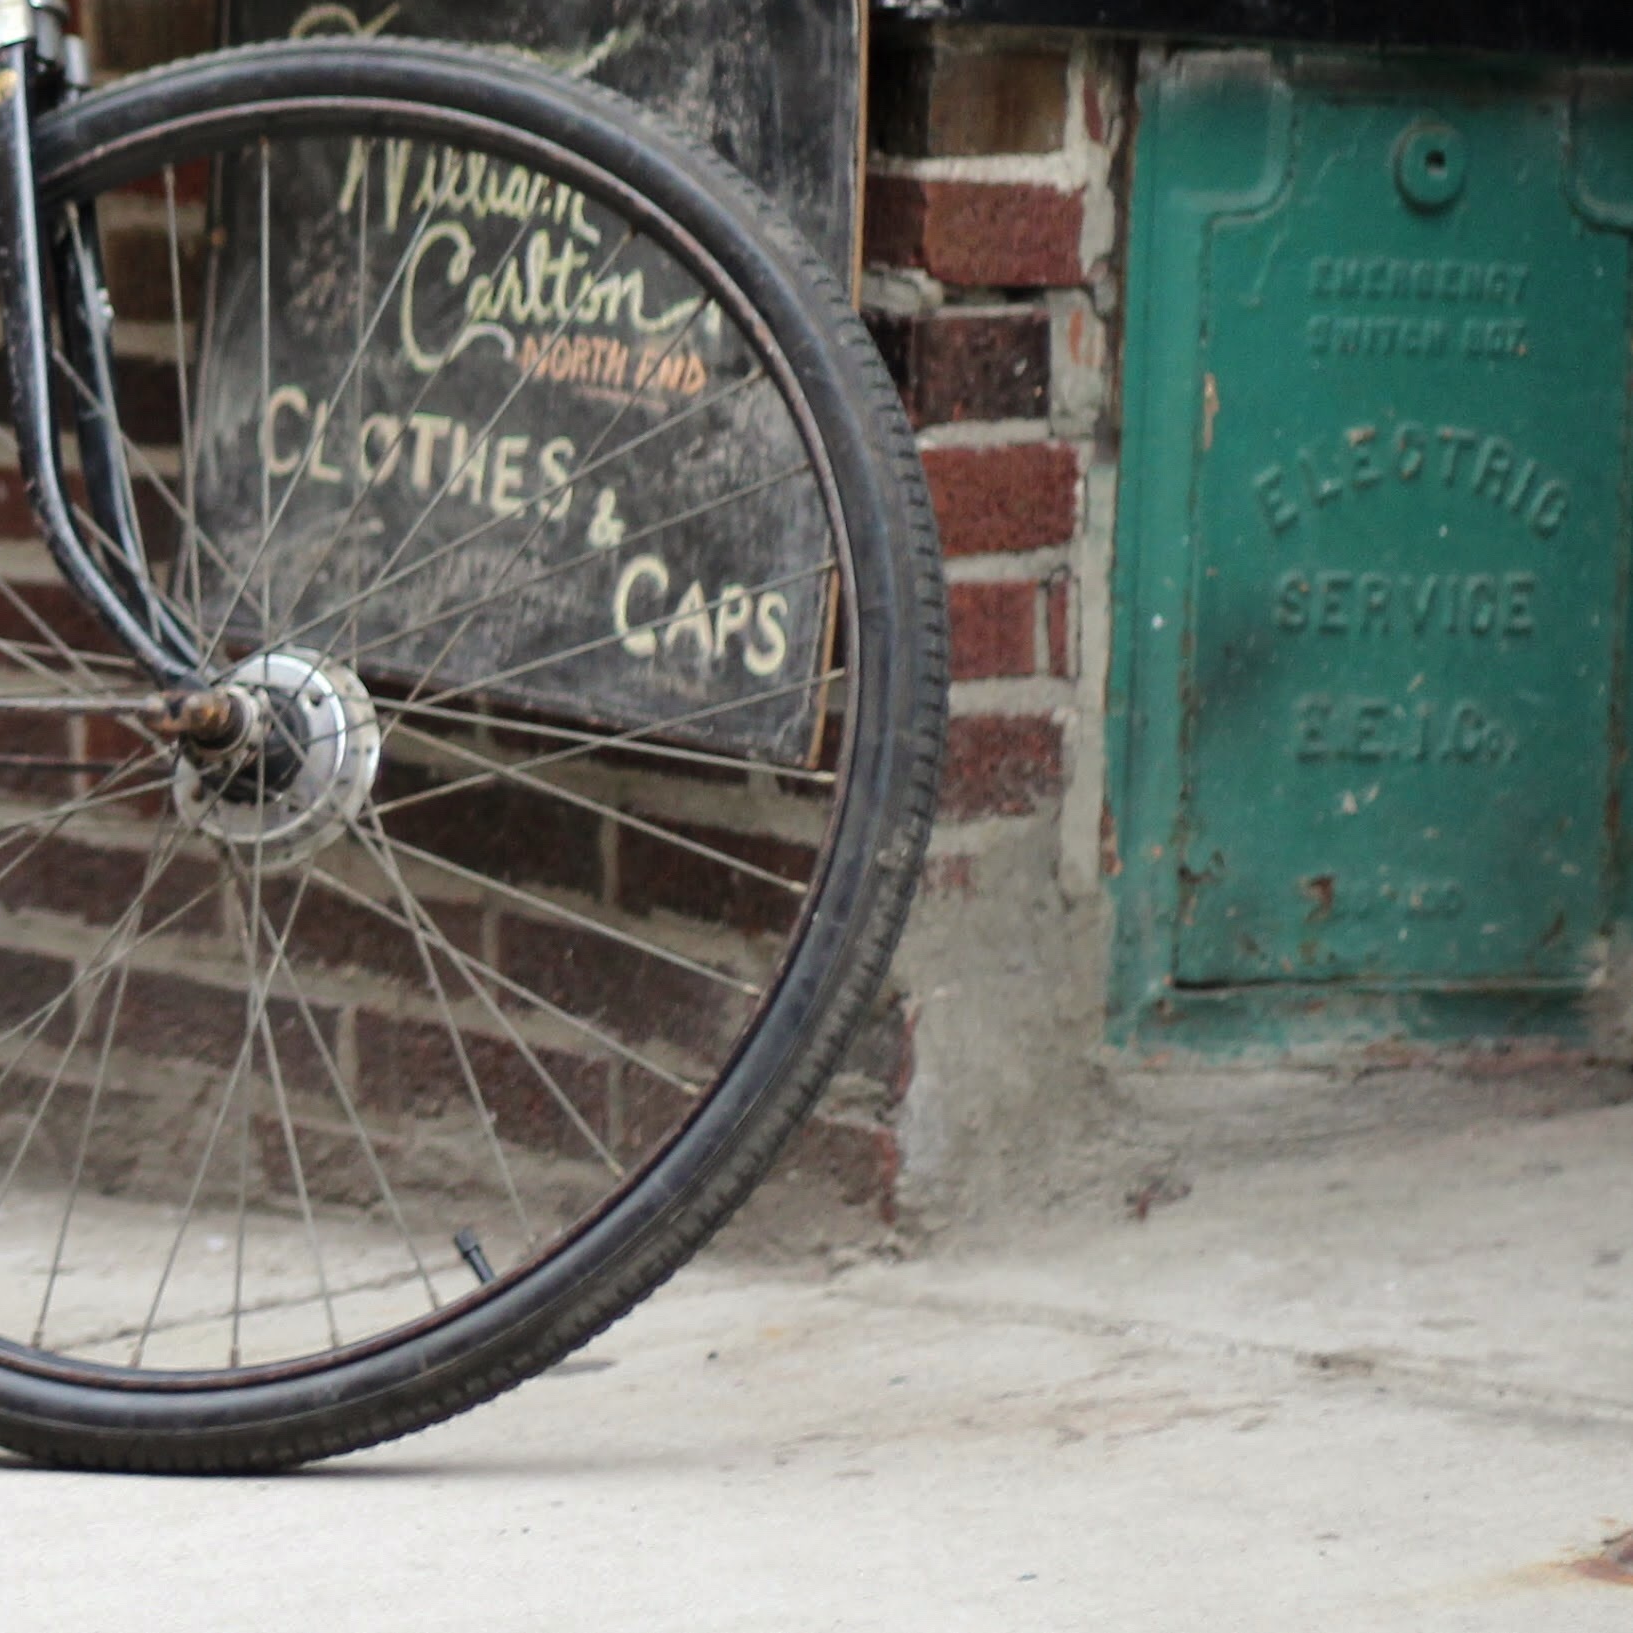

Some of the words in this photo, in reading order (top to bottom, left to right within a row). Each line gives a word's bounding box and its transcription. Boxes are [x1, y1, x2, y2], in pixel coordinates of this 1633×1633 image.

[399, 220, 723, 372] Carlton
[518, 333, 630, 386] NORTH
[636, 347, 708, 396] END
[257, 384, 576, 521] CLOTHES
[1253, 420, 1570, 538] ELECTRIC
[588, 486, 626, 547] &
[612, 554, 790, 675] CAPS
[1275, 571, 1538, 637] SERVICE
